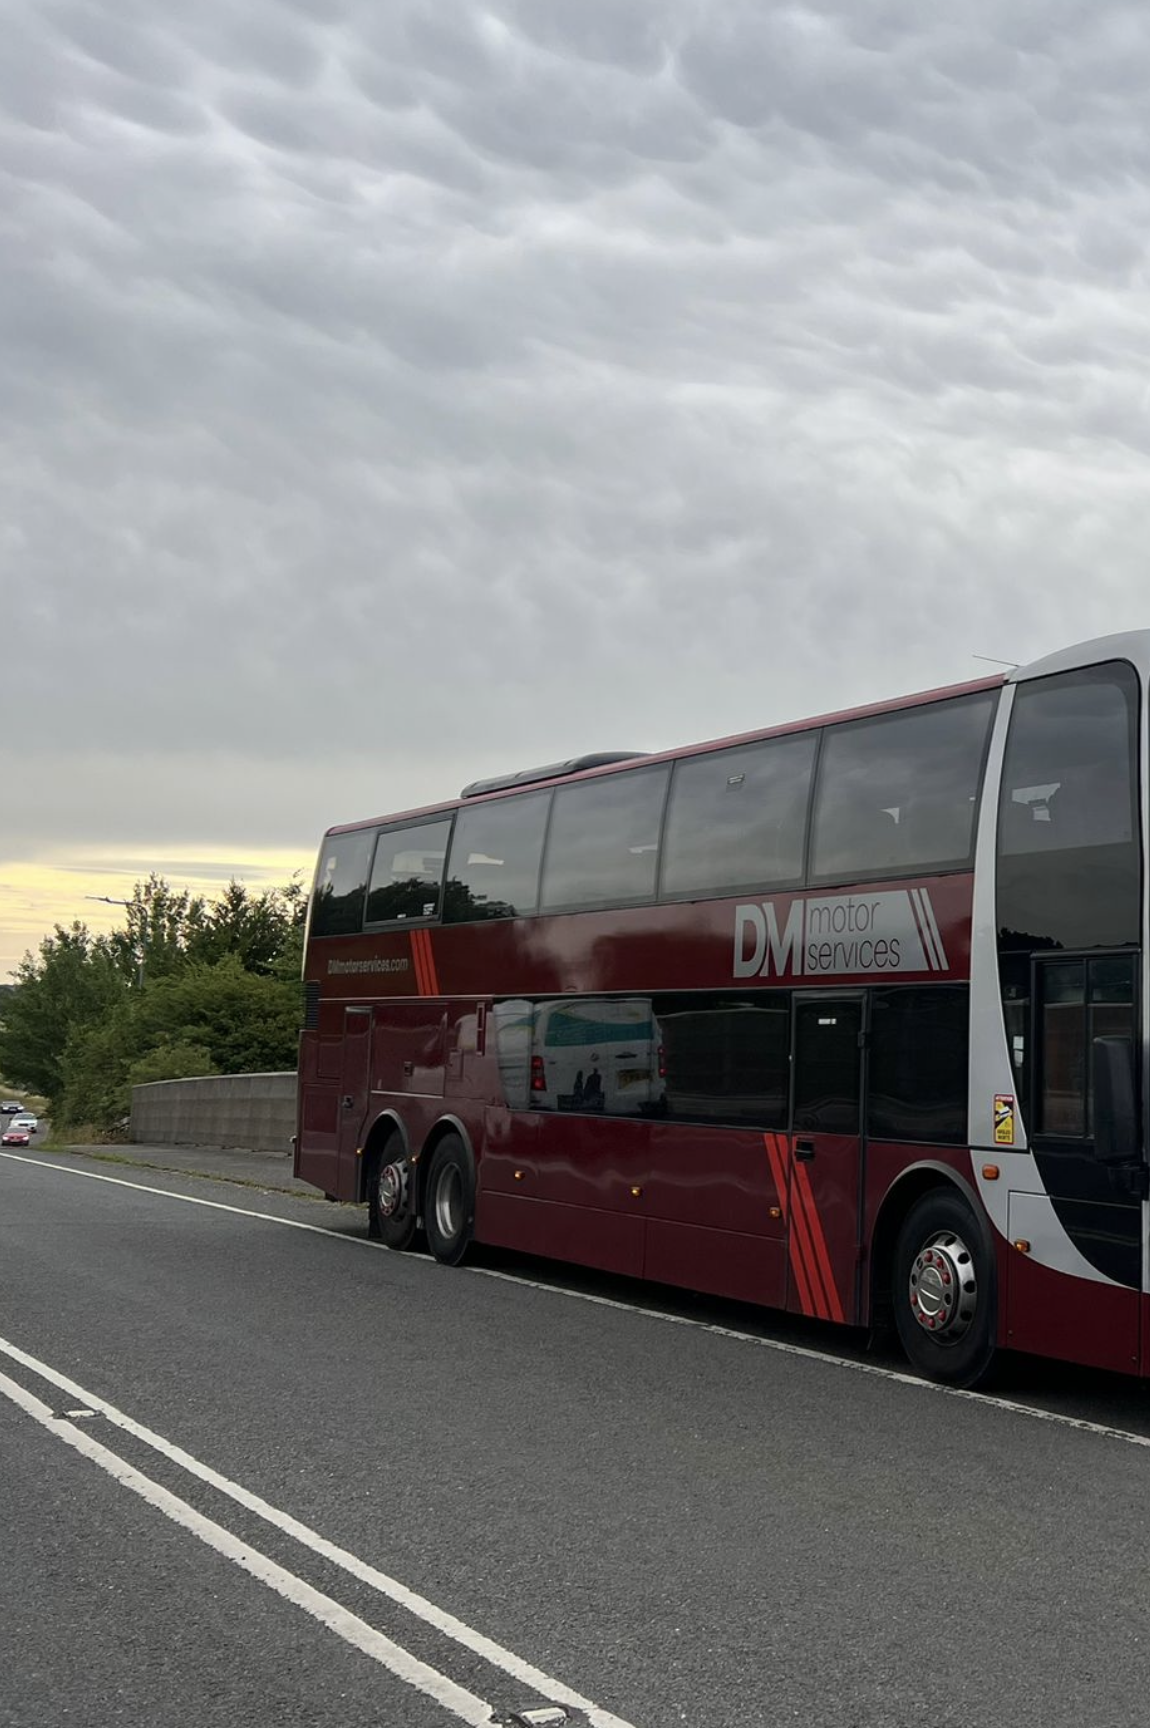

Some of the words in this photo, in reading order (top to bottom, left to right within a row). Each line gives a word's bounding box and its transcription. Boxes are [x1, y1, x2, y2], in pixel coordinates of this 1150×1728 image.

[809, 897, 881, 935] motor
[733, 899, 805, 978] DM
[807, 938, 900, 971] services
